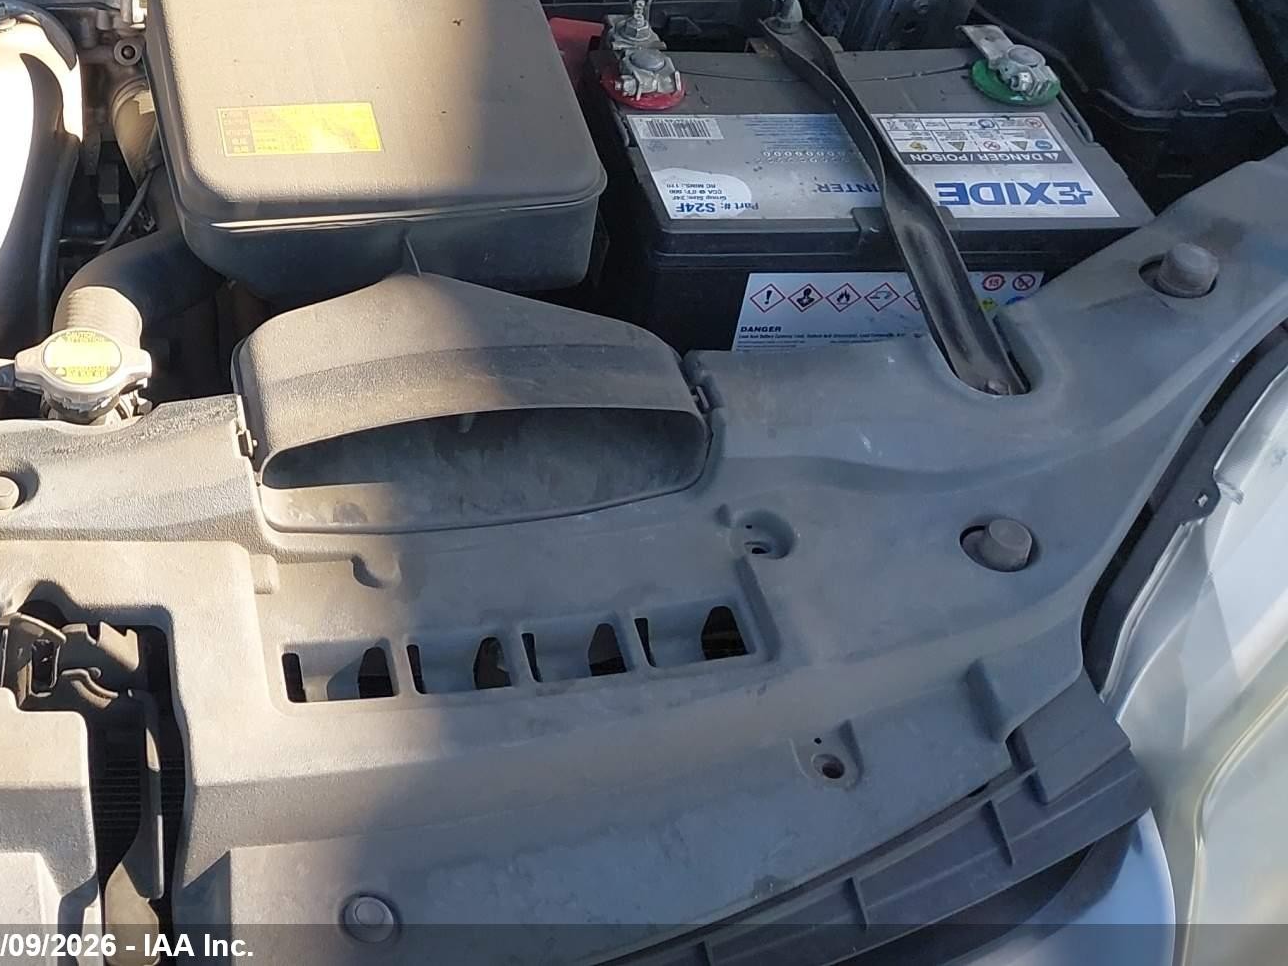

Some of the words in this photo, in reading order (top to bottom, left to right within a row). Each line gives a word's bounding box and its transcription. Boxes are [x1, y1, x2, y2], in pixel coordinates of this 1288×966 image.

[909, 152, 968, 162] POISON
[976, 151, 1043, 163] DANGER
[934, 182, 1094, 206] EXIDE
[675, 202, 716, 213] S24F
[735, 202, 760, 211] Part
[740, 325, 782, 333] DANGER
